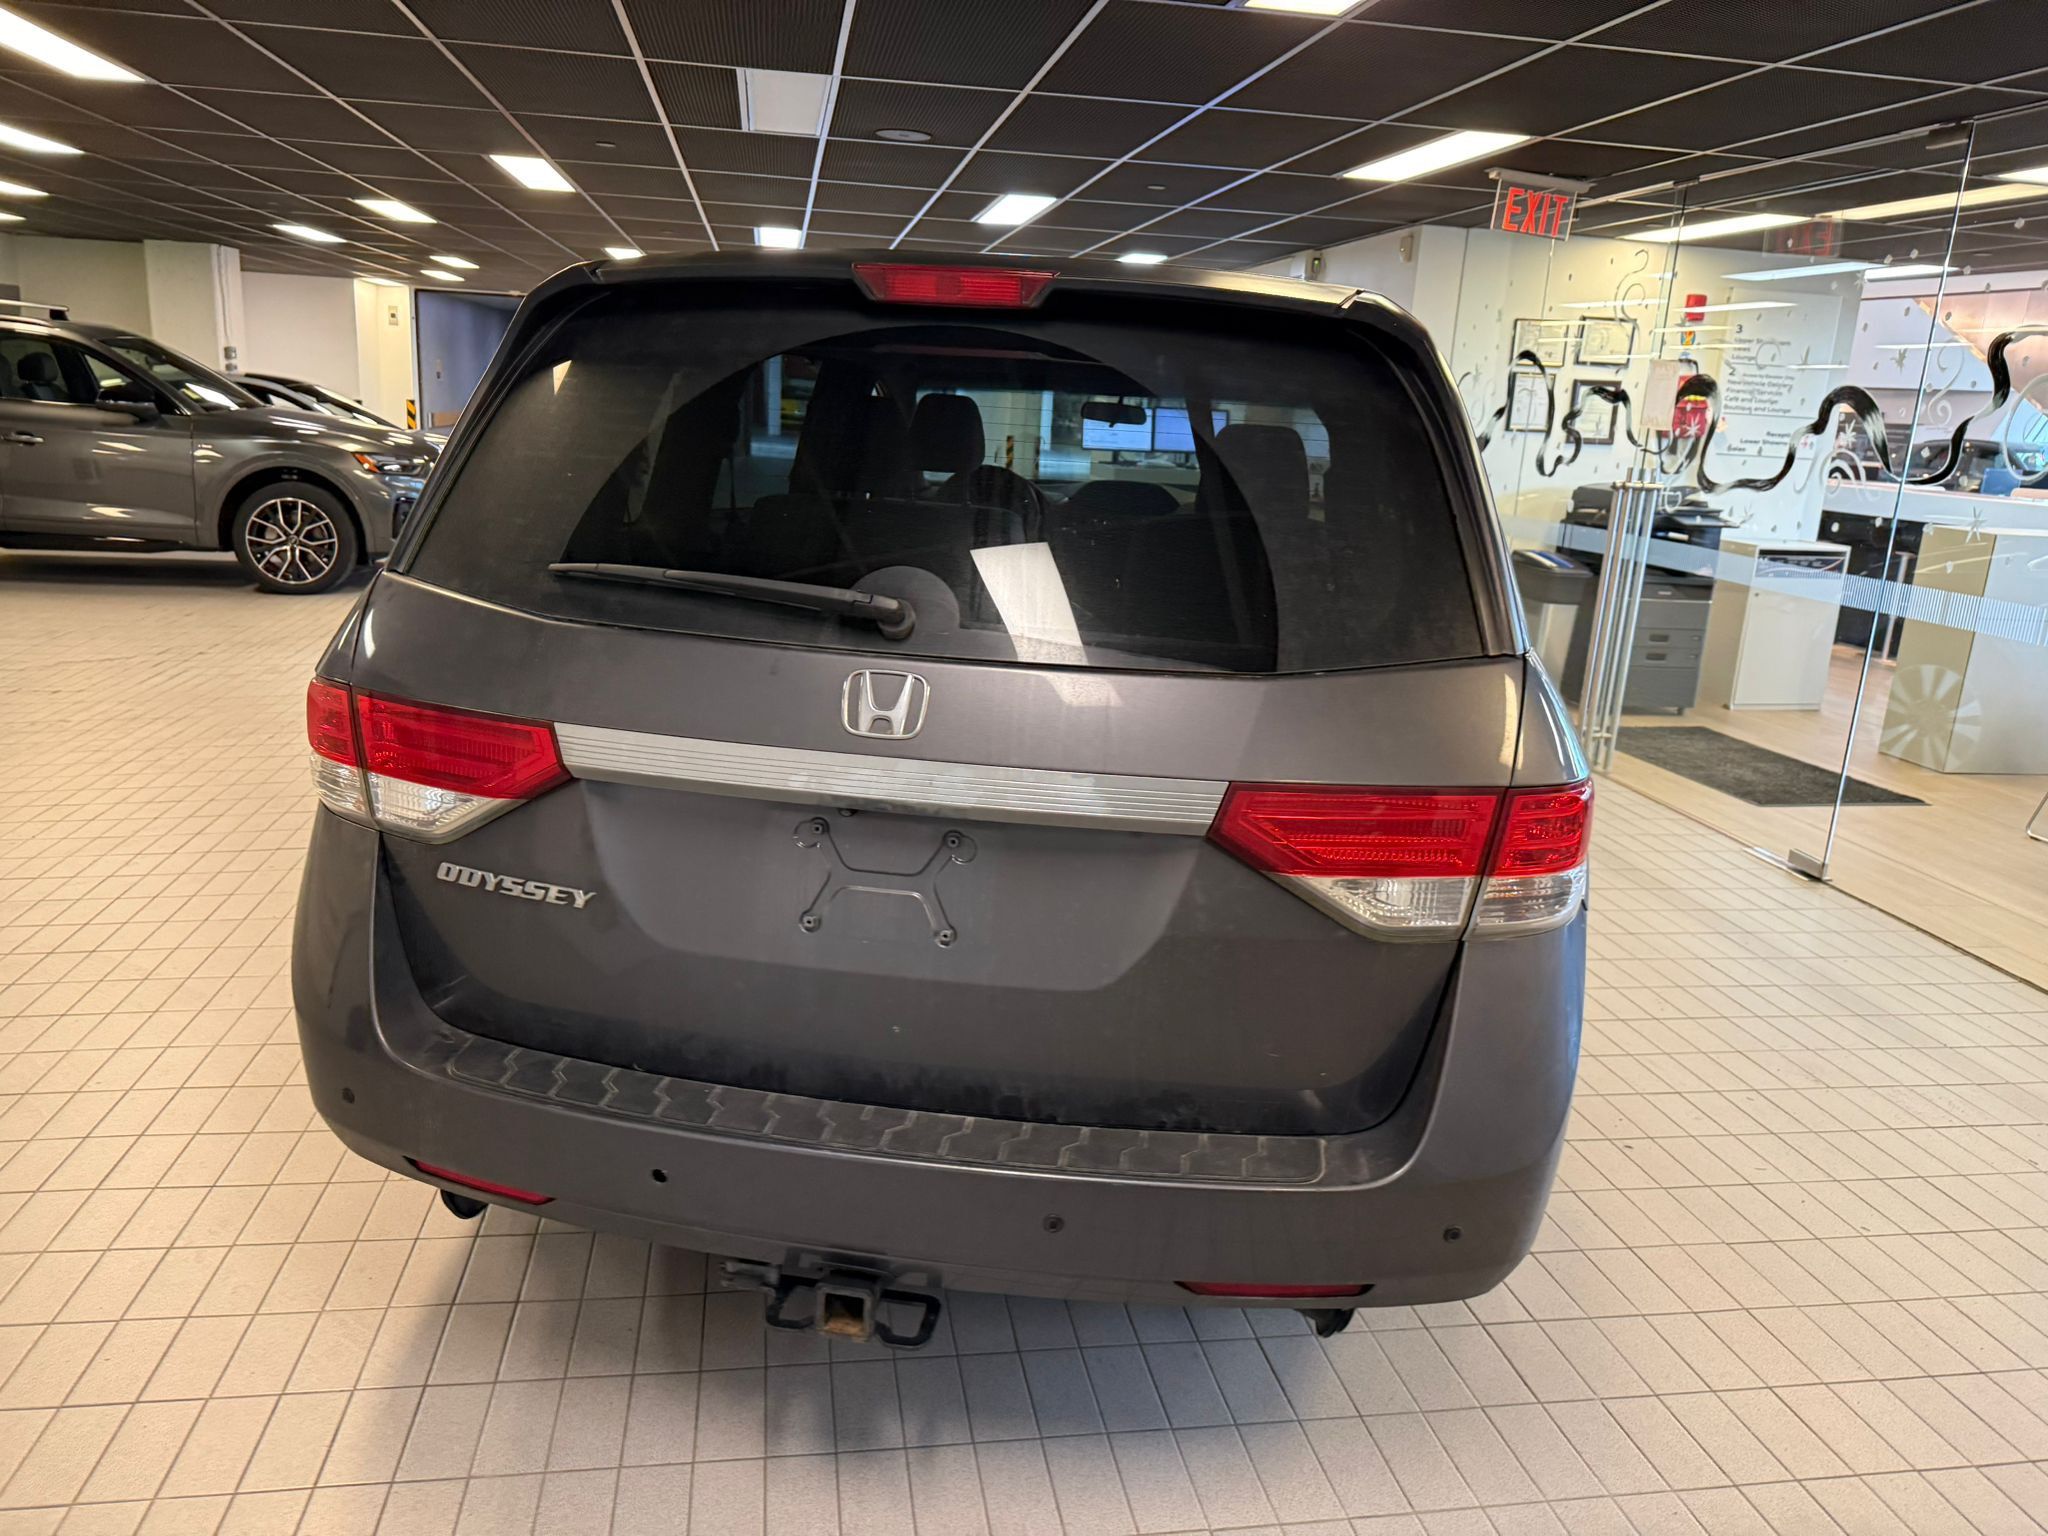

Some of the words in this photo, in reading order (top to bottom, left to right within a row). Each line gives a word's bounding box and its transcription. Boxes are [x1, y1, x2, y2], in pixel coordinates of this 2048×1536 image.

[1502, 187, 1568, 237] EXIT
[1735, 324, 1743, 334] 3
[1728, 367, 1736, 376] 2
[1754, 397, 1778, 405] Lounge
[1767, 406, 1791, 414] Lounge
[436, 862, 597, 909] ODYSSEY
